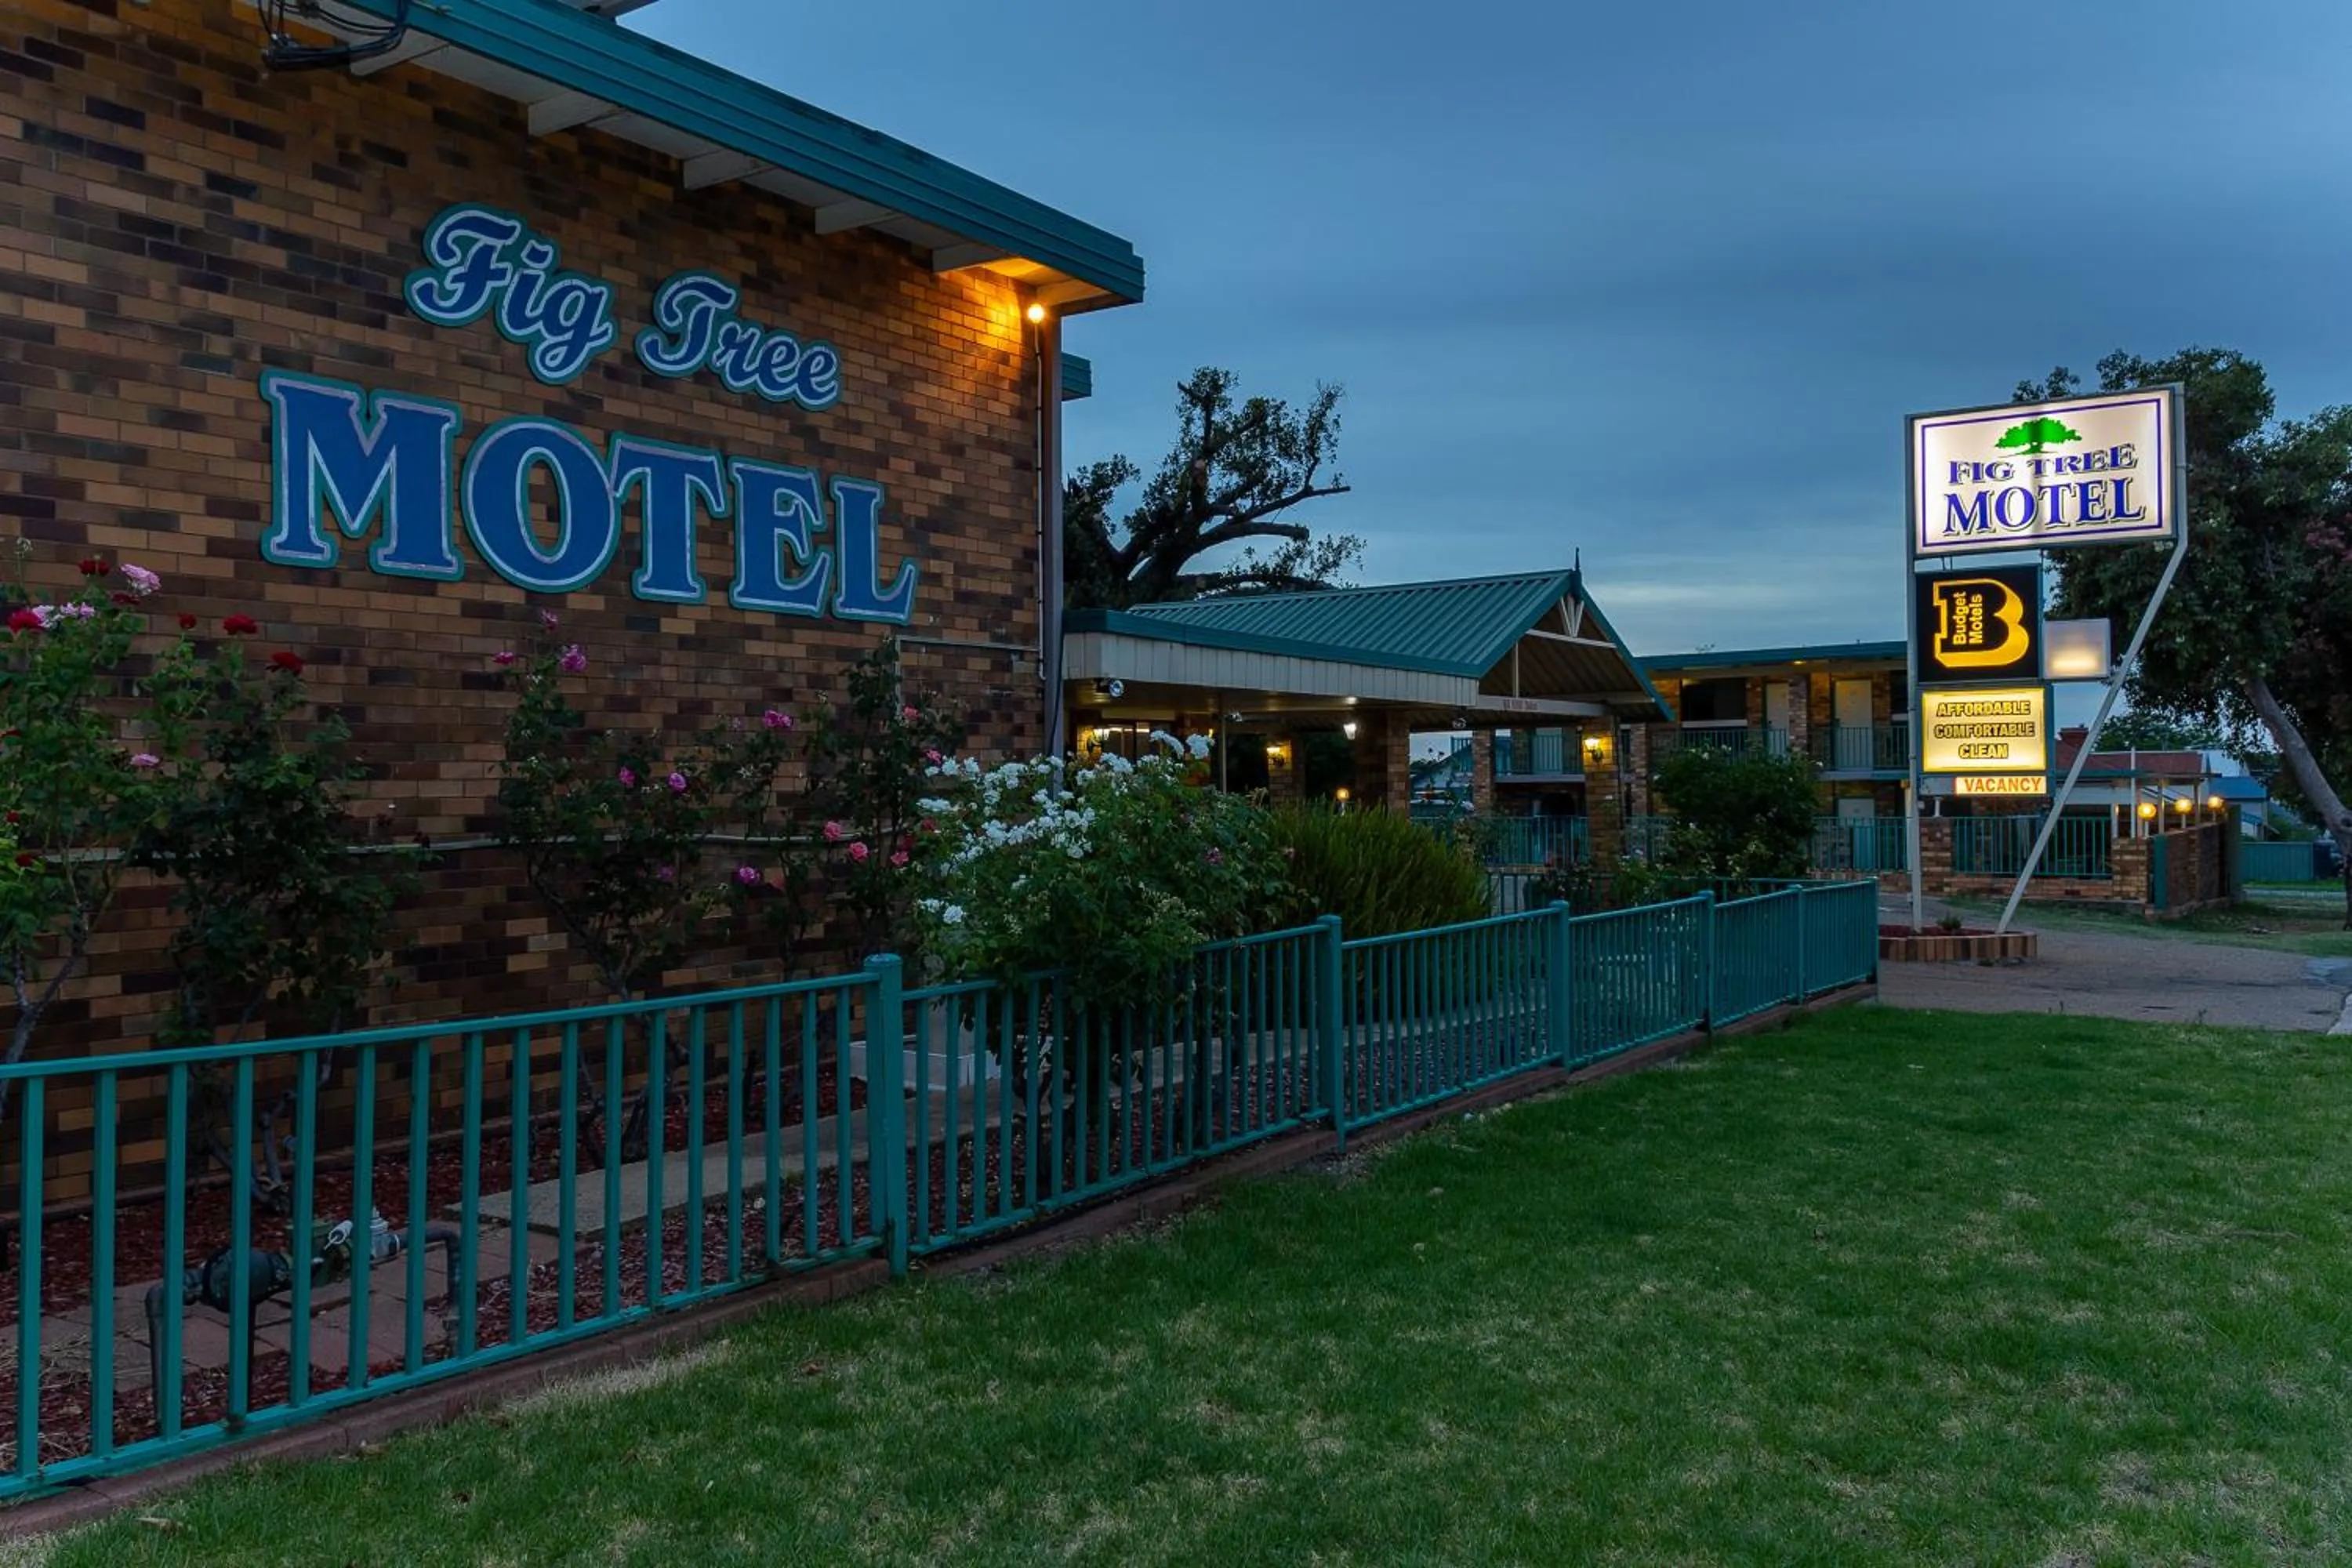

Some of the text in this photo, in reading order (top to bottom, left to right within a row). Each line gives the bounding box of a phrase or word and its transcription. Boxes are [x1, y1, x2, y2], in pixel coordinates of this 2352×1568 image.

[406, 203, 840, 410] Fig Tree
[1947, 442, 2138, 486] FIG TREE
[261, 370, 918, 624] MOTEL
[1943, 476, 2146, 536] MOTEL
[1933, 578, 2030, 668] B
[1952, 591, 1970, 645] Budget
[1969, 593, 1984, 644] Motels
[1934, 721, 2036, 739] COMFORTABLE
[1936, 700, 2031, 717] AFFORDABLE
[1958, 743, 2009, 760] CLEAN
[1964, 777, 2042, 793] VACANCY
